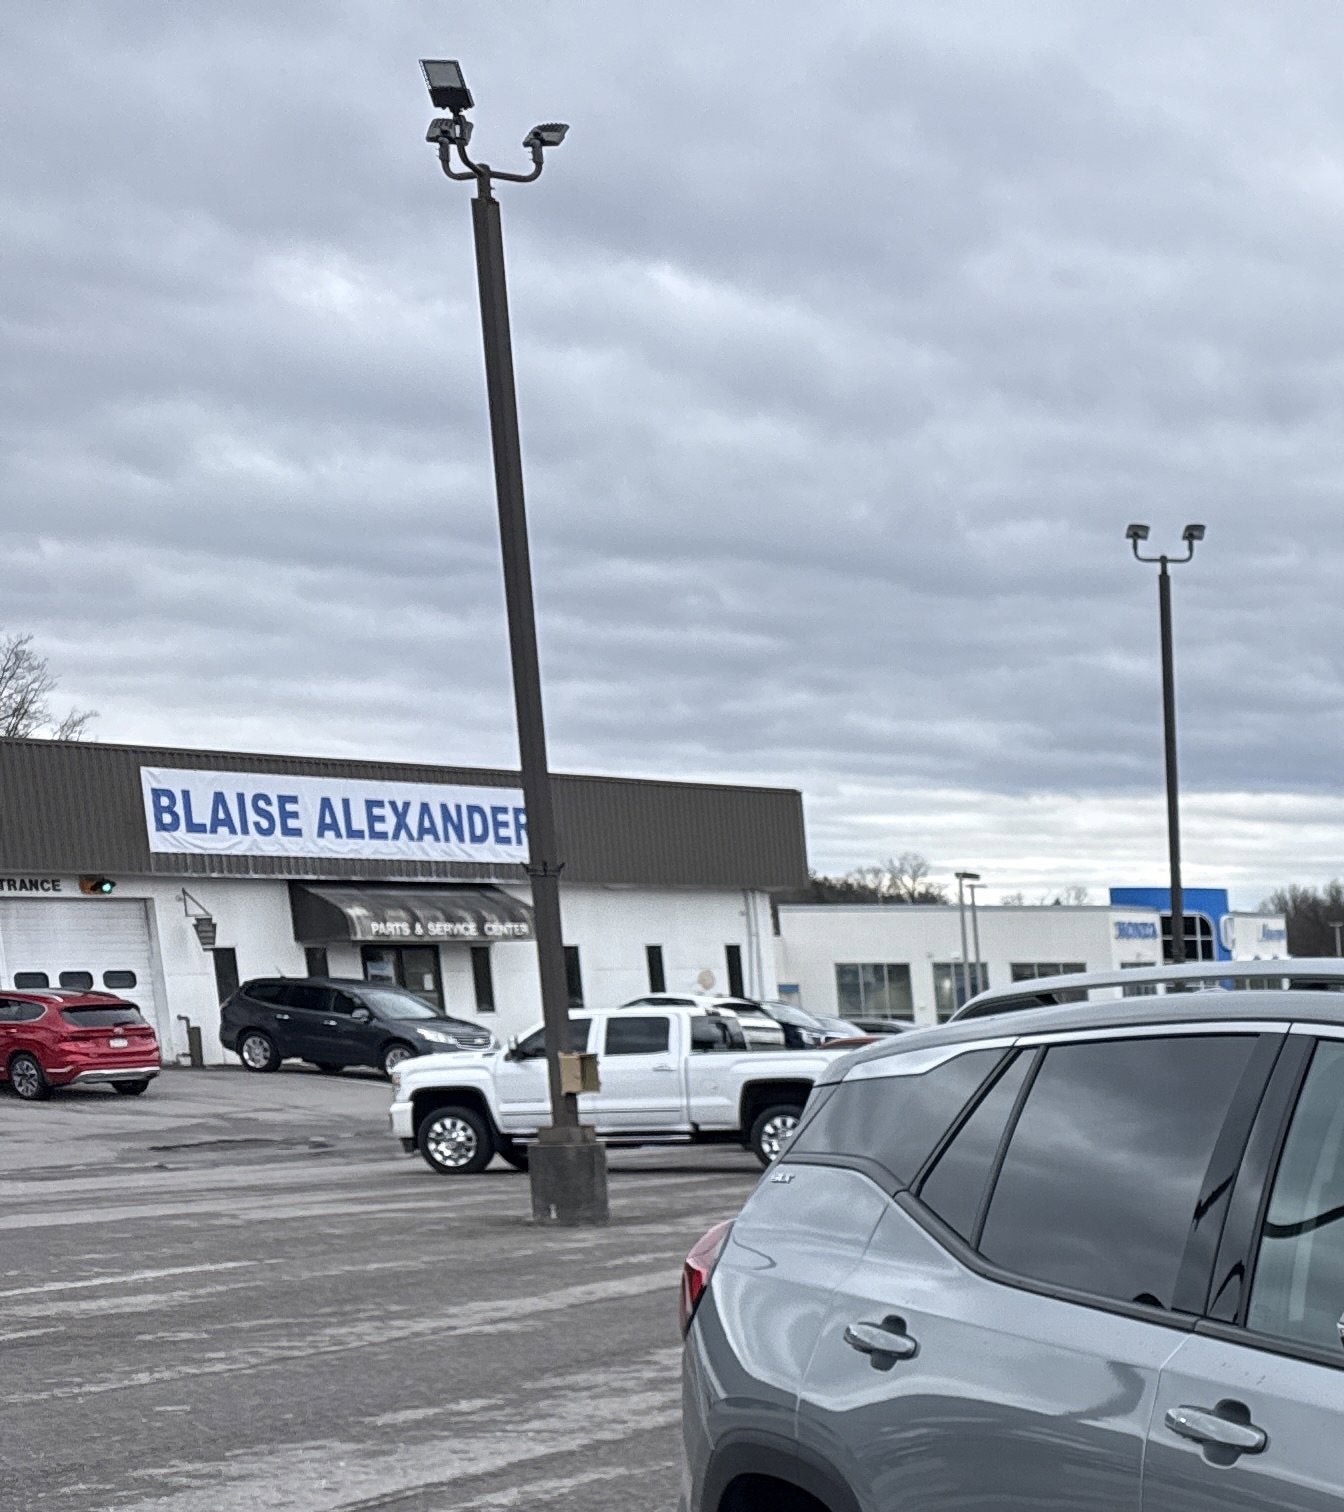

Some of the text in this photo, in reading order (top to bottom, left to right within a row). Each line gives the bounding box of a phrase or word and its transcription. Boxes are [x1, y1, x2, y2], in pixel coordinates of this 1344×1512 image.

[150, 787, 302, 838] BLAISE
[370, 921, 411, 936] PARTS
[427, 921, 478, 936] SERVICE
